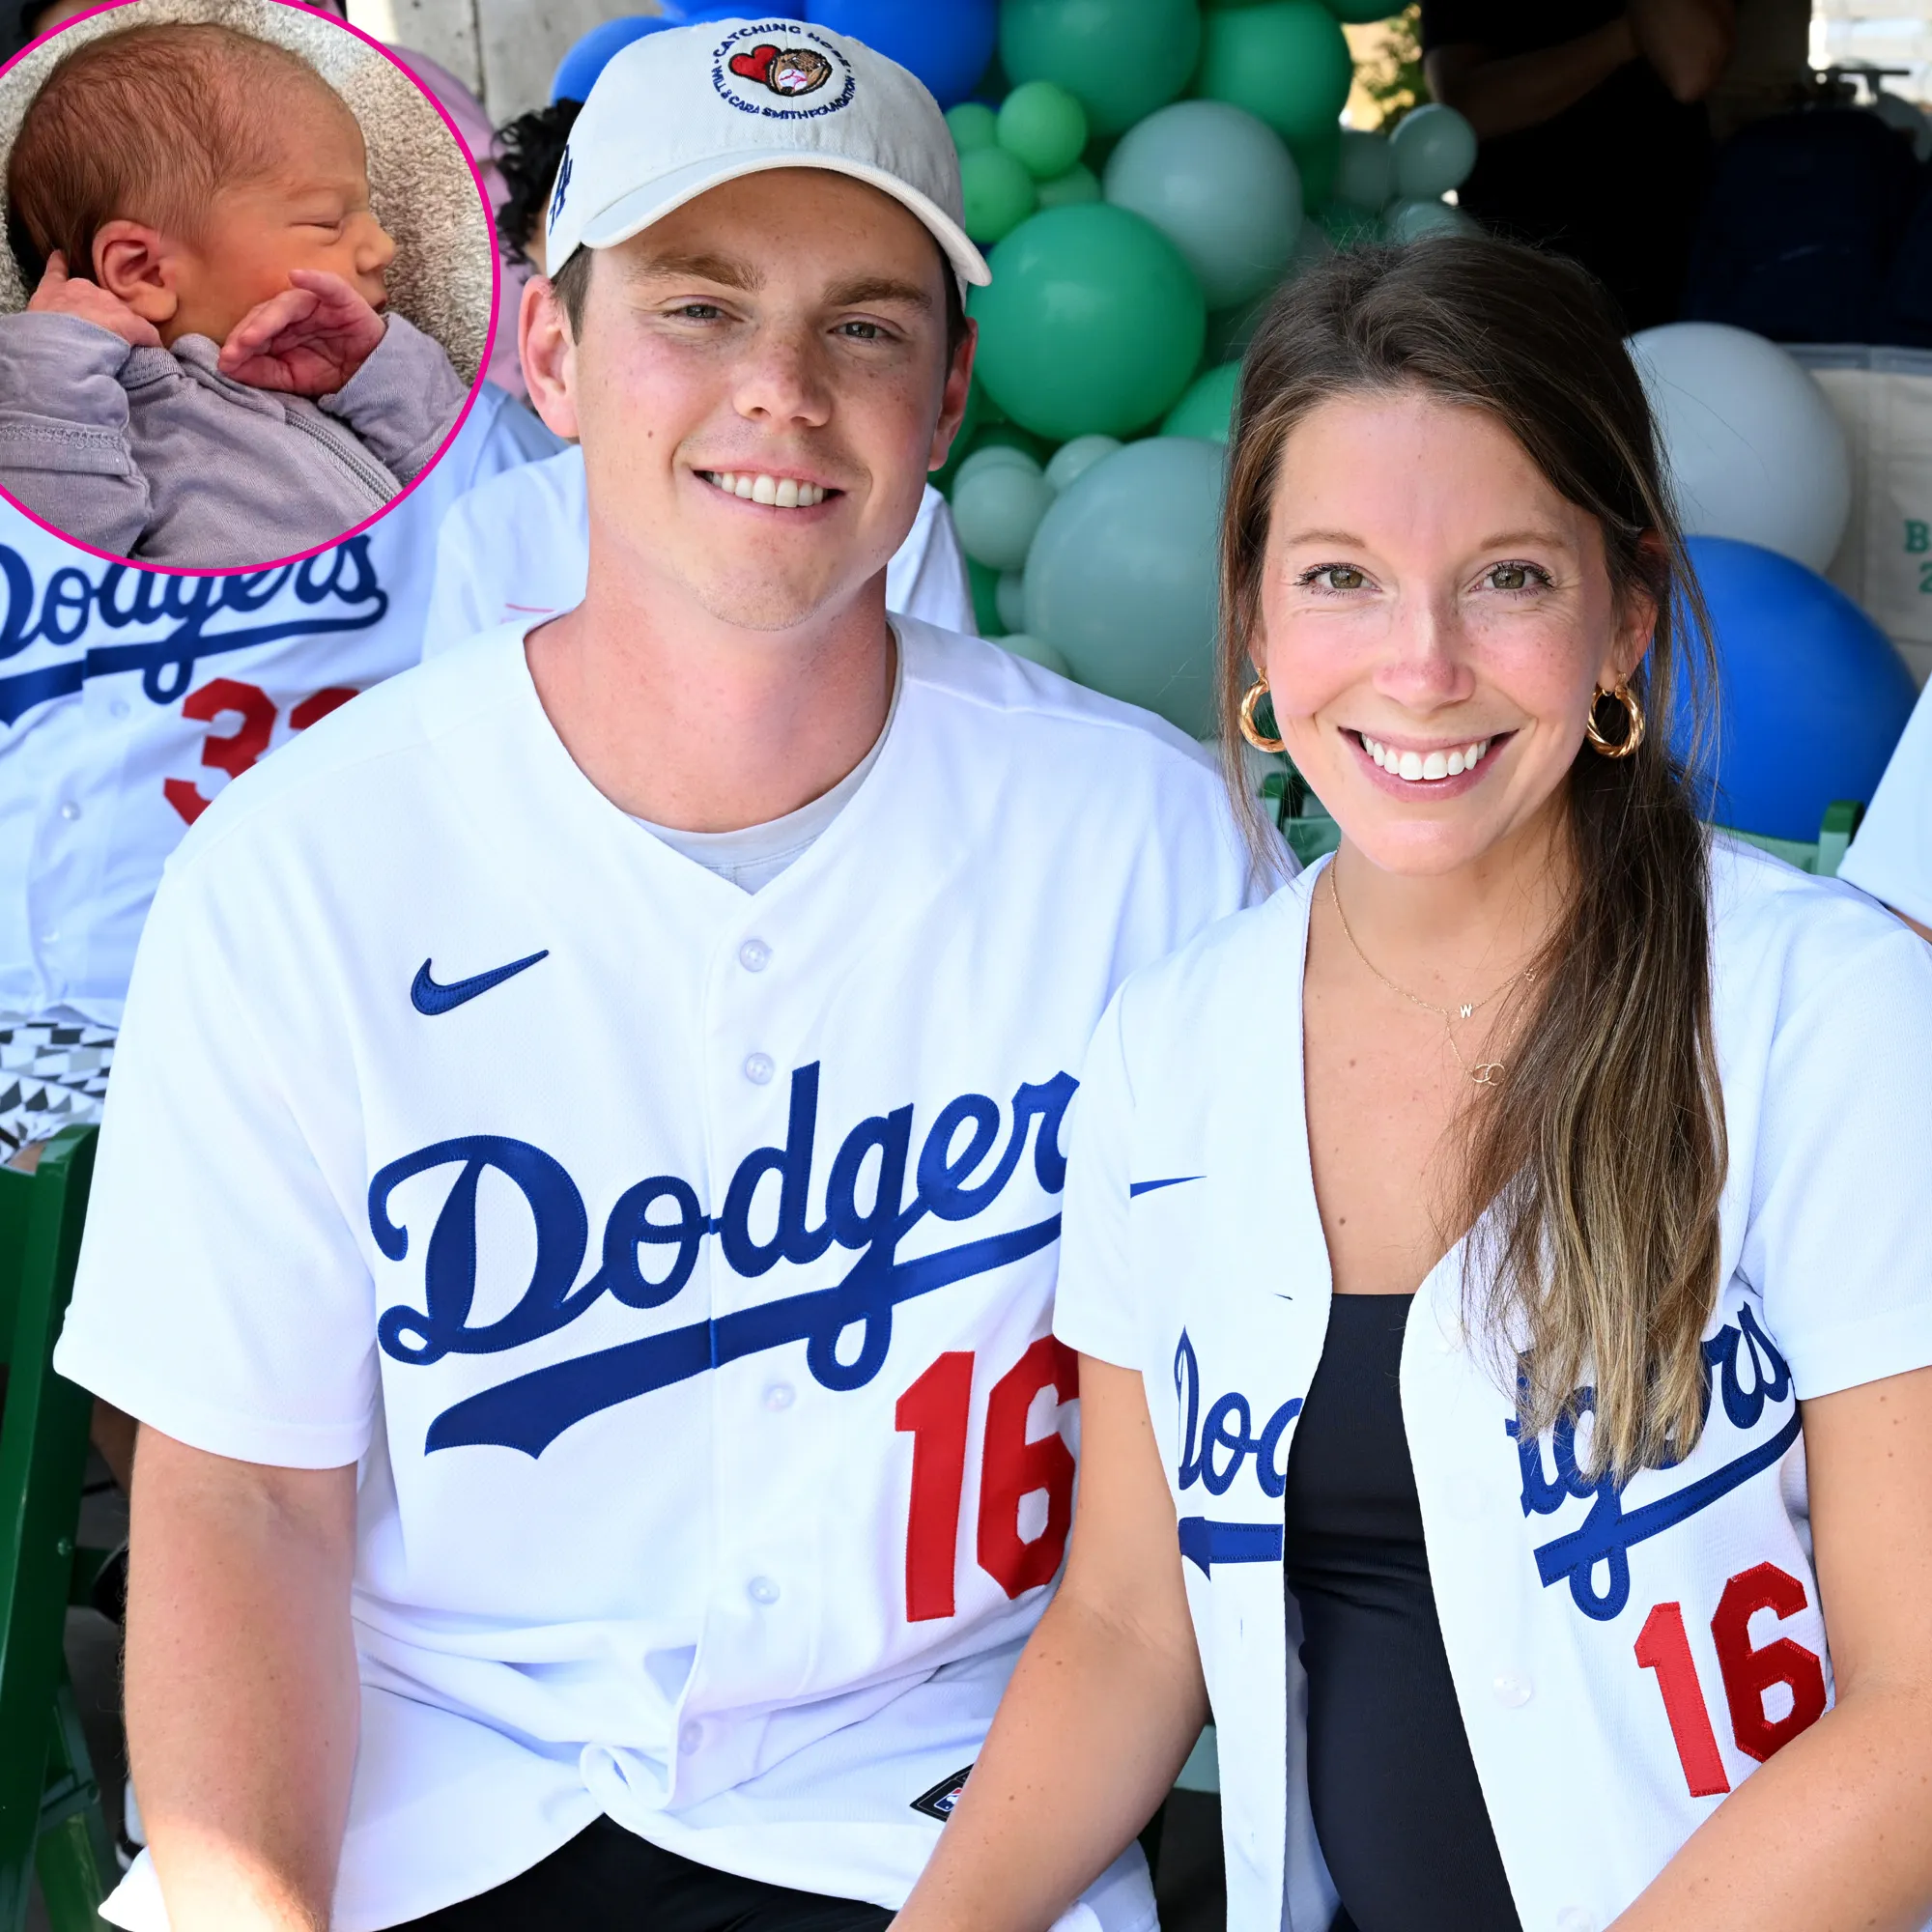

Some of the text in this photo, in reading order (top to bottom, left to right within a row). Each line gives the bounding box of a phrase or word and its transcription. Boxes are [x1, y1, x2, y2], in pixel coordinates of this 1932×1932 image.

[711, 65, 856, 120] WILL & CARA SMITH FOUNDATION
[713, 23, 851, 68] CATCHING HOPE
[163, 677, 360, 826] 3
[1460, 1003, 1473, 1019] W
[368, 1060, 1080, 1391] Dodger
[895, 1333, 1080, 1623] 16
[1634, 1561, 1827, 1798] 16
